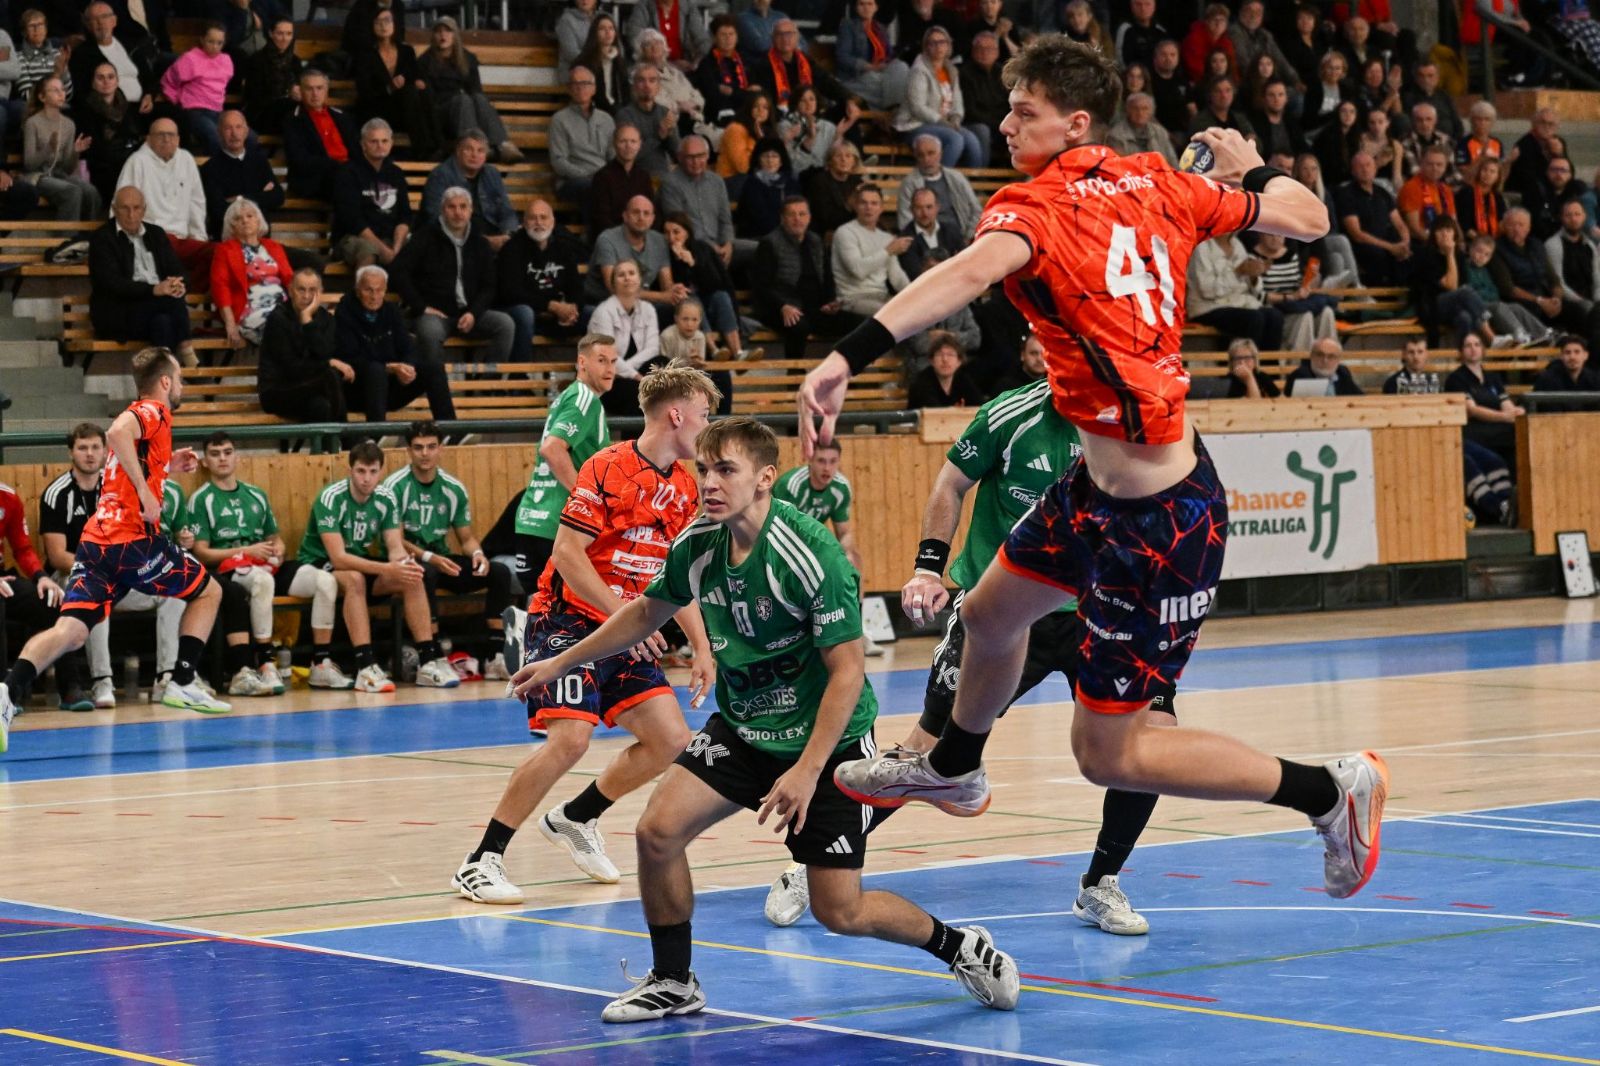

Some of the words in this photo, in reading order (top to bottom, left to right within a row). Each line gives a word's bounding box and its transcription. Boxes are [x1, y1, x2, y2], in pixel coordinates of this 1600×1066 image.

[1105, 222, 1177, 328] 41
[651, 482, 676, 511] 10
[234, 508, 247, 528] 2
[420, 504, 433, 525] 17
[353, 521, 368, 541] 18
[1226, 517, 1306, 536] XTRALIGA
[556, 674, 583, 705] 10
